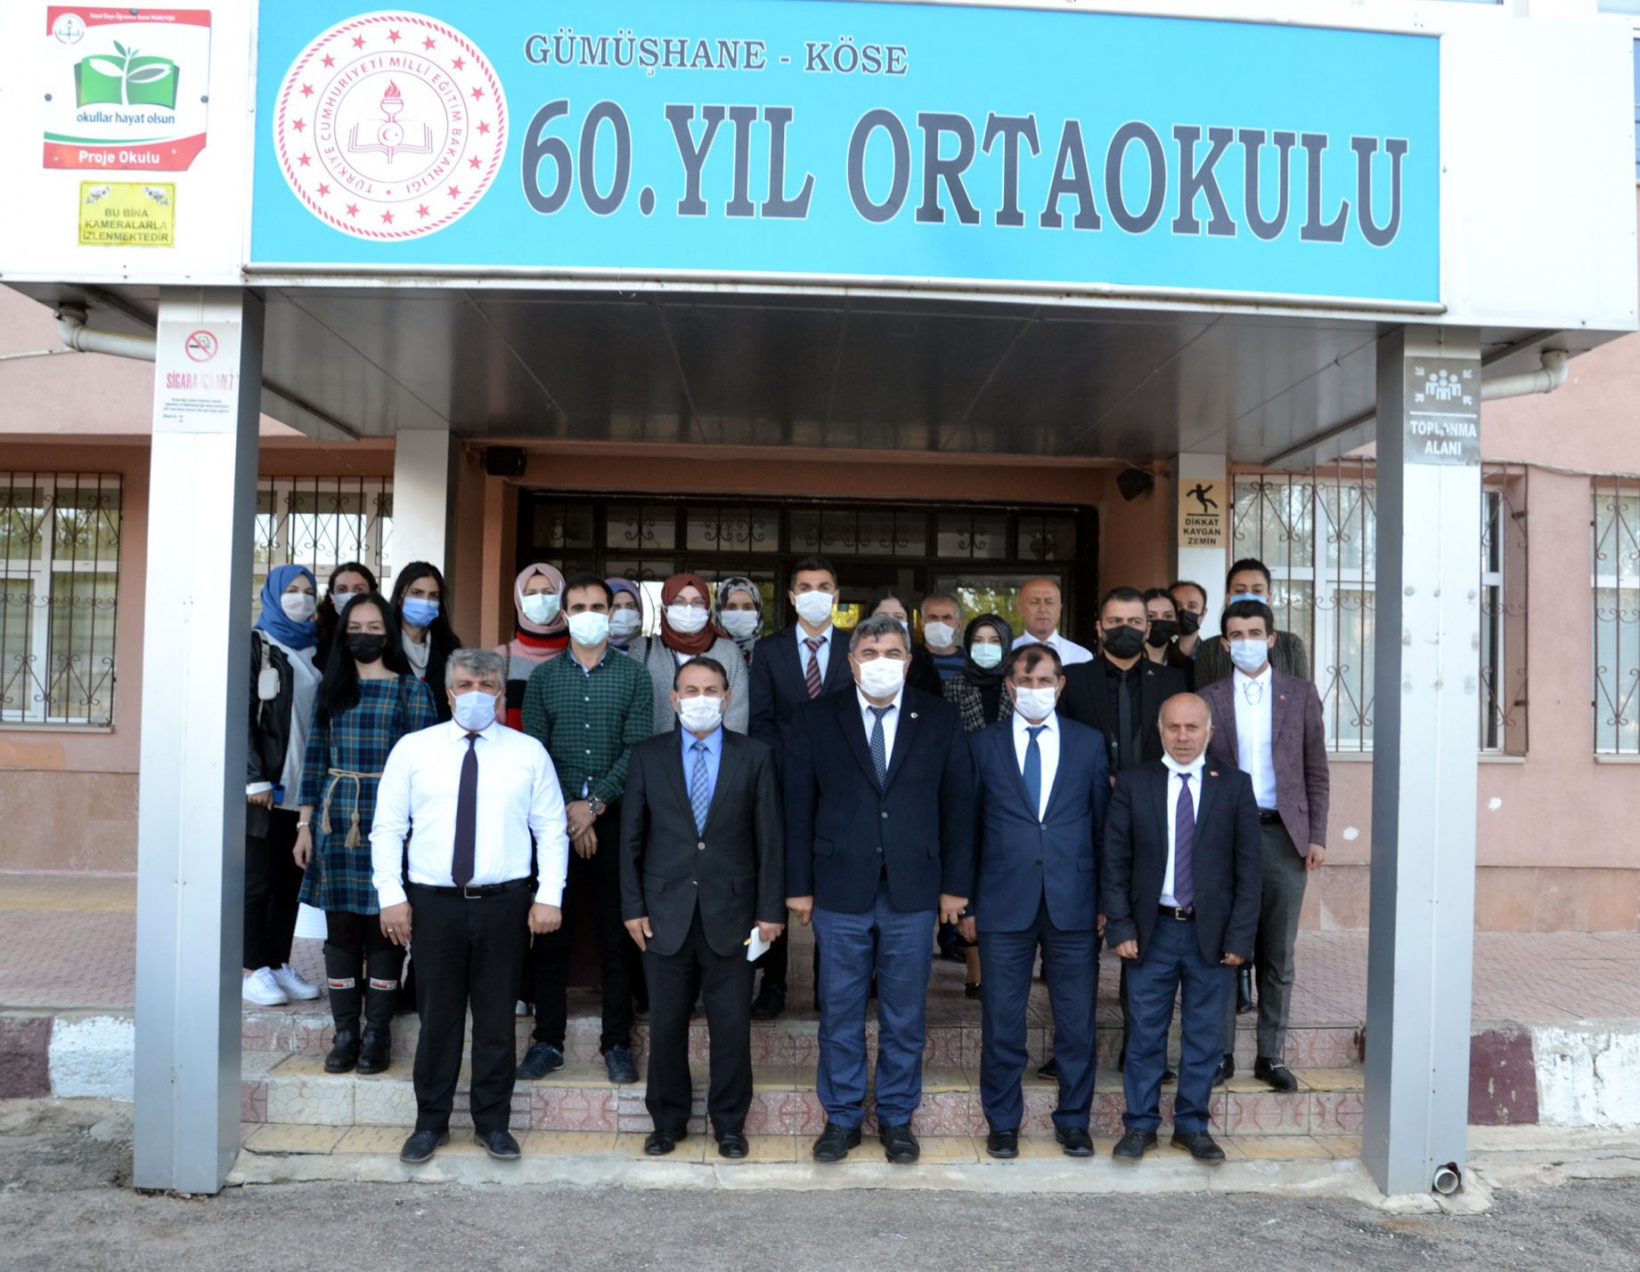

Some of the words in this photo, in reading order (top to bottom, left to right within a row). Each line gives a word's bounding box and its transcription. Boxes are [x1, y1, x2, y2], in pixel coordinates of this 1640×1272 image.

[524, 27, 767, 76] GÜMÜŞHANE
[804, 36, 908, 76] KÖSE
[389, 55, 432, 76] MİLLİ
[320, 56, 383, 141] CUMHURİYETİ
[431, 73, 462, 122] EĞİTİM
[76, 111, 113, 123] okullar
[115, 112, 145, 126] hayat
[147, 112, 175, 124] olsun
[78, 149, 116, 166] Proje
[119, 150, 160, 164] Okulu
[406, 128, 462, 194] BAKANLIĞI
[324, 146, 372, 193] TÜRKİYE
[521, 98, 816, 221] 60.YIL
[846, 107, 1409, 247] ORTAOKULU
[104, 207, 120, 217] BU
[123, 206, 149, 218] BİNA
[85, 220, 168, 230] KAMERALARLA
[83, 230, 169, 242] İZLENMEKTEDİR
[1410, 420, 1478, 438] TOPLANMA
[1424, 440, 1462, 456] ALANI
[1185, 517, 1219, 526] DİKKAT
[1183, 527, 1221, 536] KAYGAN
[1188, 536, 1217, 545] ZEMİN
